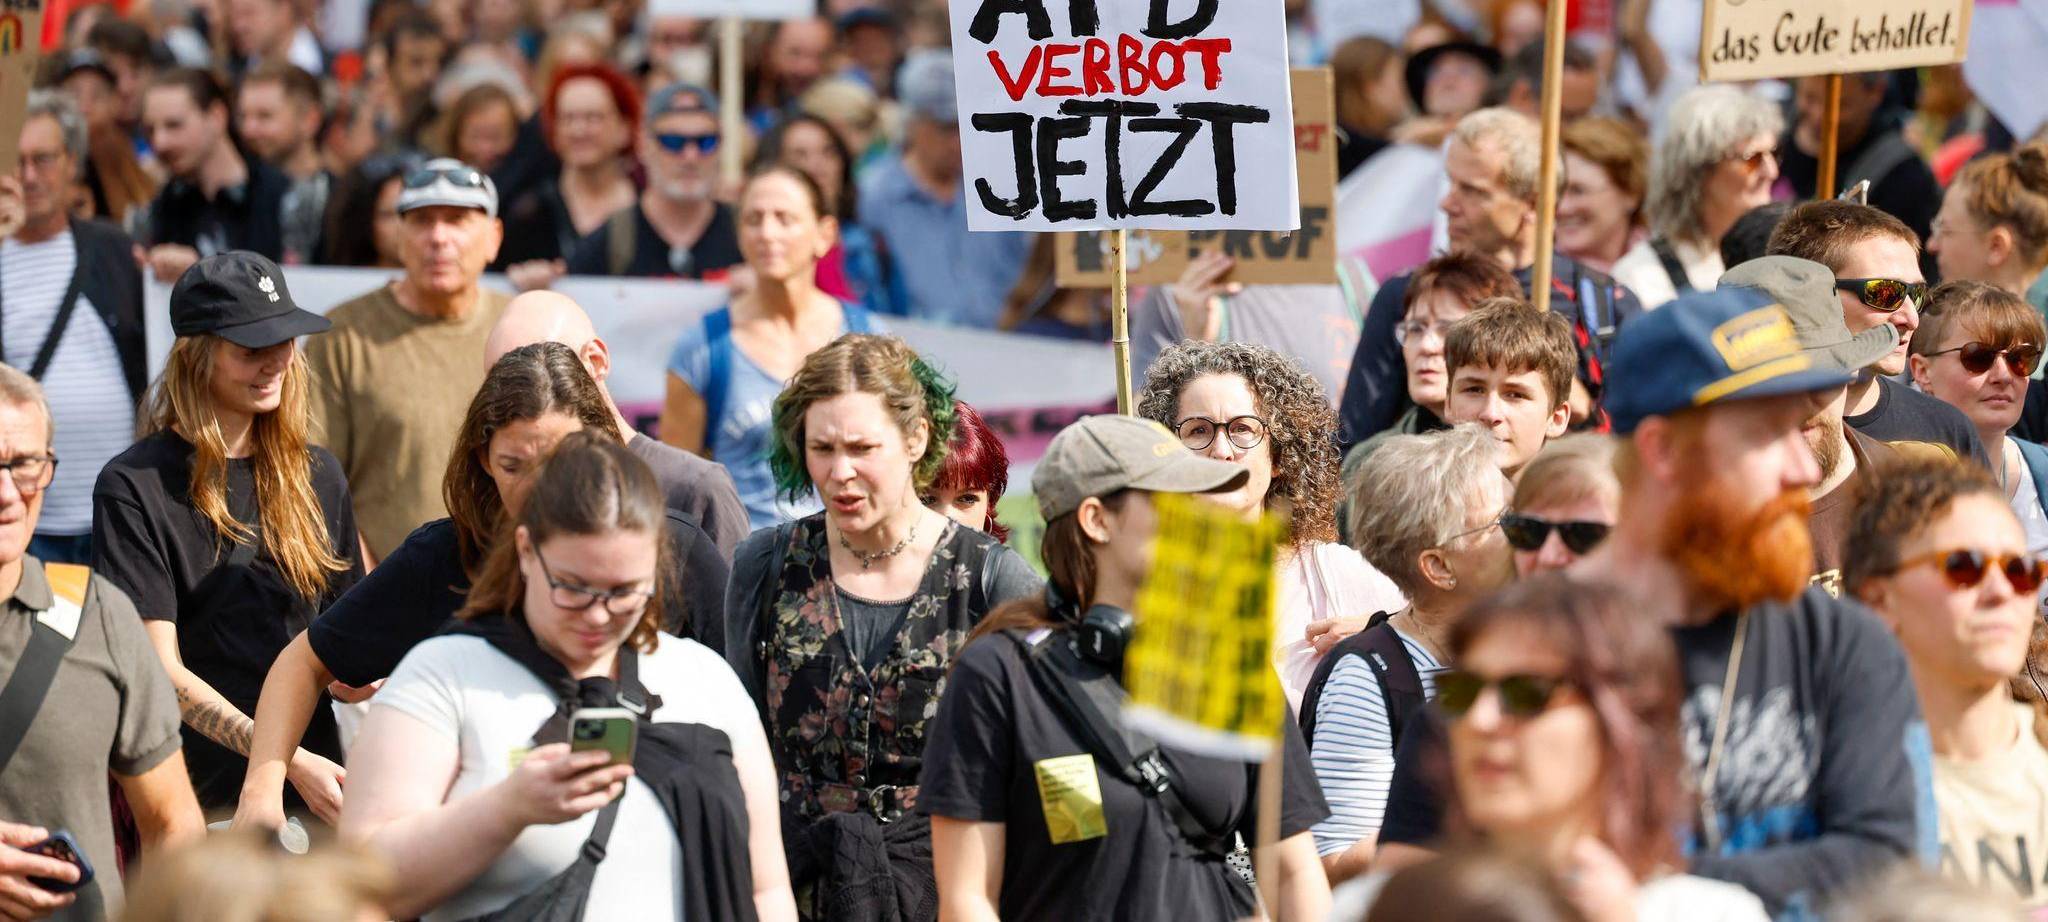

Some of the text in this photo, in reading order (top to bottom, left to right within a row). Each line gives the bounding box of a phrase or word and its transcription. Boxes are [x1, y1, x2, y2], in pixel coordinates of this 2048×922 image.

[987, 33, 1231, 101] VERBOT
[1712, 29, 1759, 63] das
[1773, 12, 1839, 55] Gute
[971, 98, 1270, 223] JETZT
